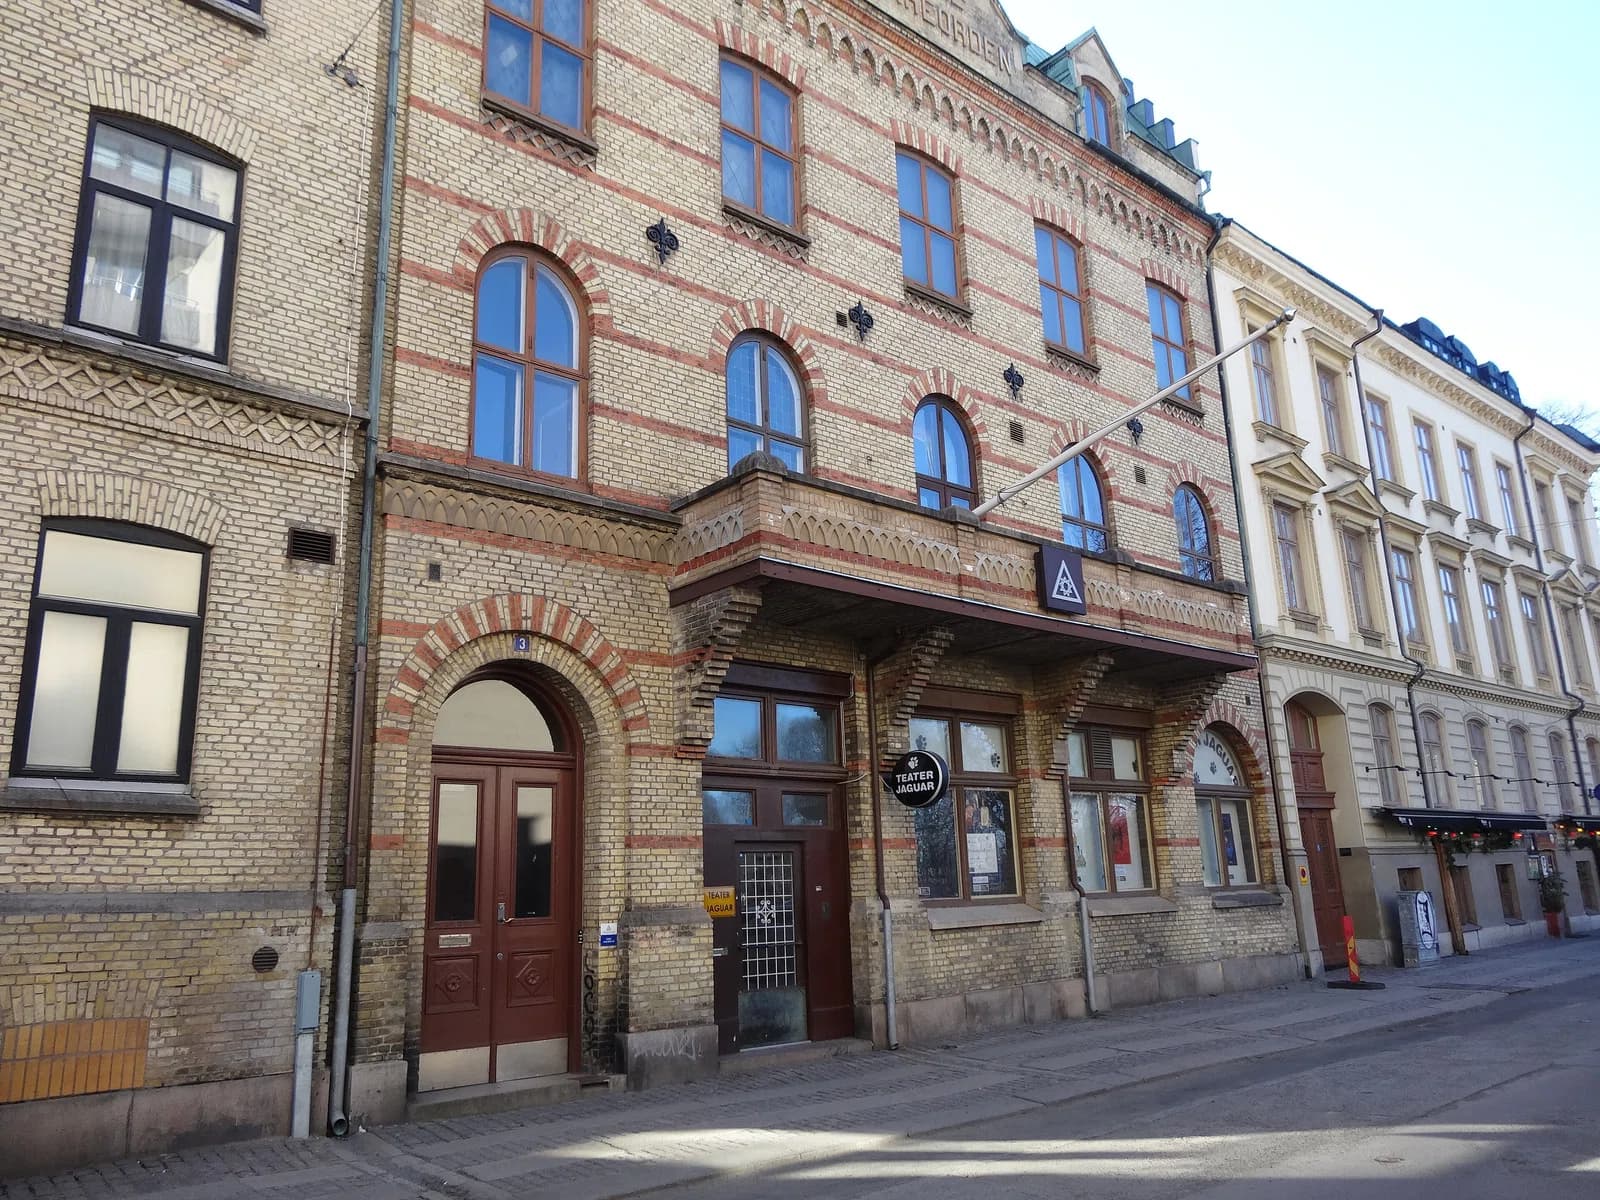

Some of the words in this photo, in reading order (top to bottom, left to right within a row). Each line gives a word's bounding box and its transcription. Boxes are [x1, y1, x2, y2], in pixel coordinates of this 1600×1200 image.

[519, 637, 526, 650] 3
[895, 770, 934, 783] TEATER
[895, 781, 935, 794] JAGUAR
[708, 891, 730, 899] TEATER
[706, 903, 733, 912] JAGUAR
